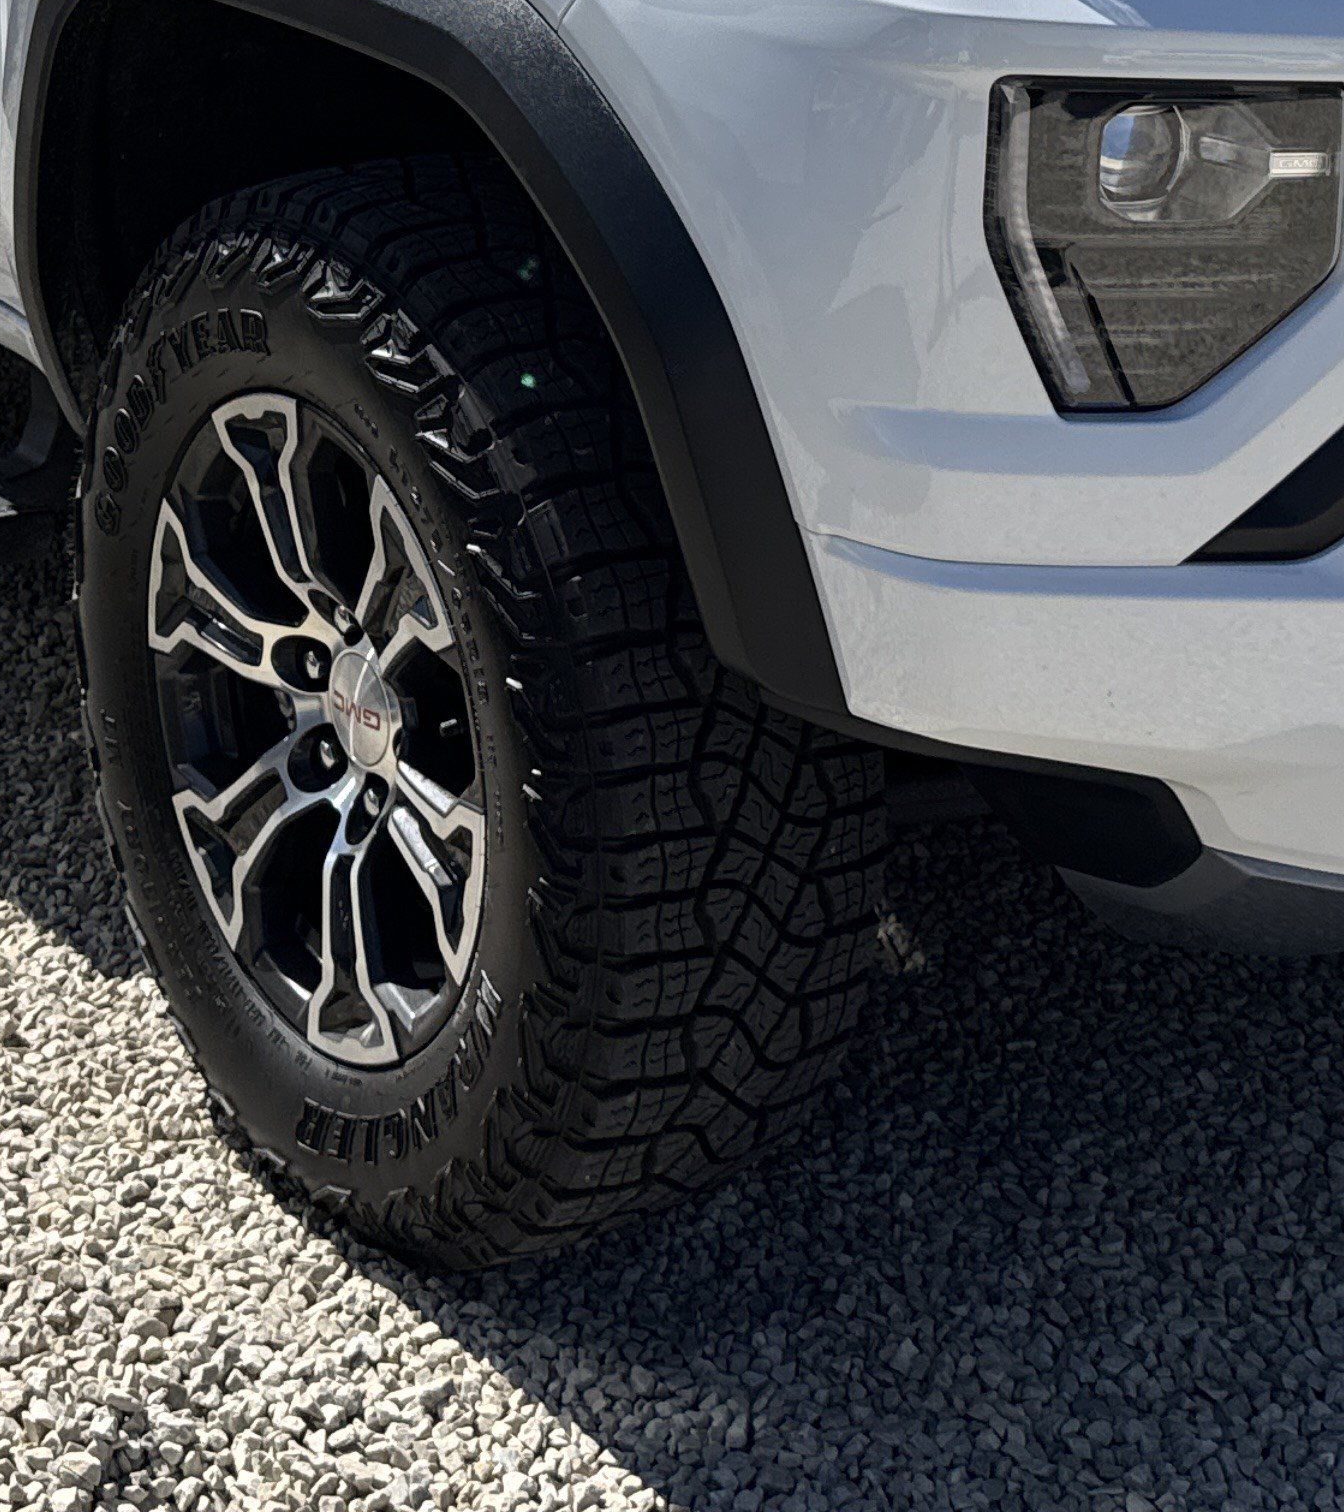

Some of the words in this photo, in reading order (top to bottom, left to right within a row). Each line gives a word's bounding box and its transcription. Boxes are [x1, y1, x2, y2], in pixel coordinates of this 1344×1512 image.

[94, 307, 271, 537] GOODYEAR
[332, 689, 382, 732] GMC
[294, 968, 503, 1166] WRANGLER
